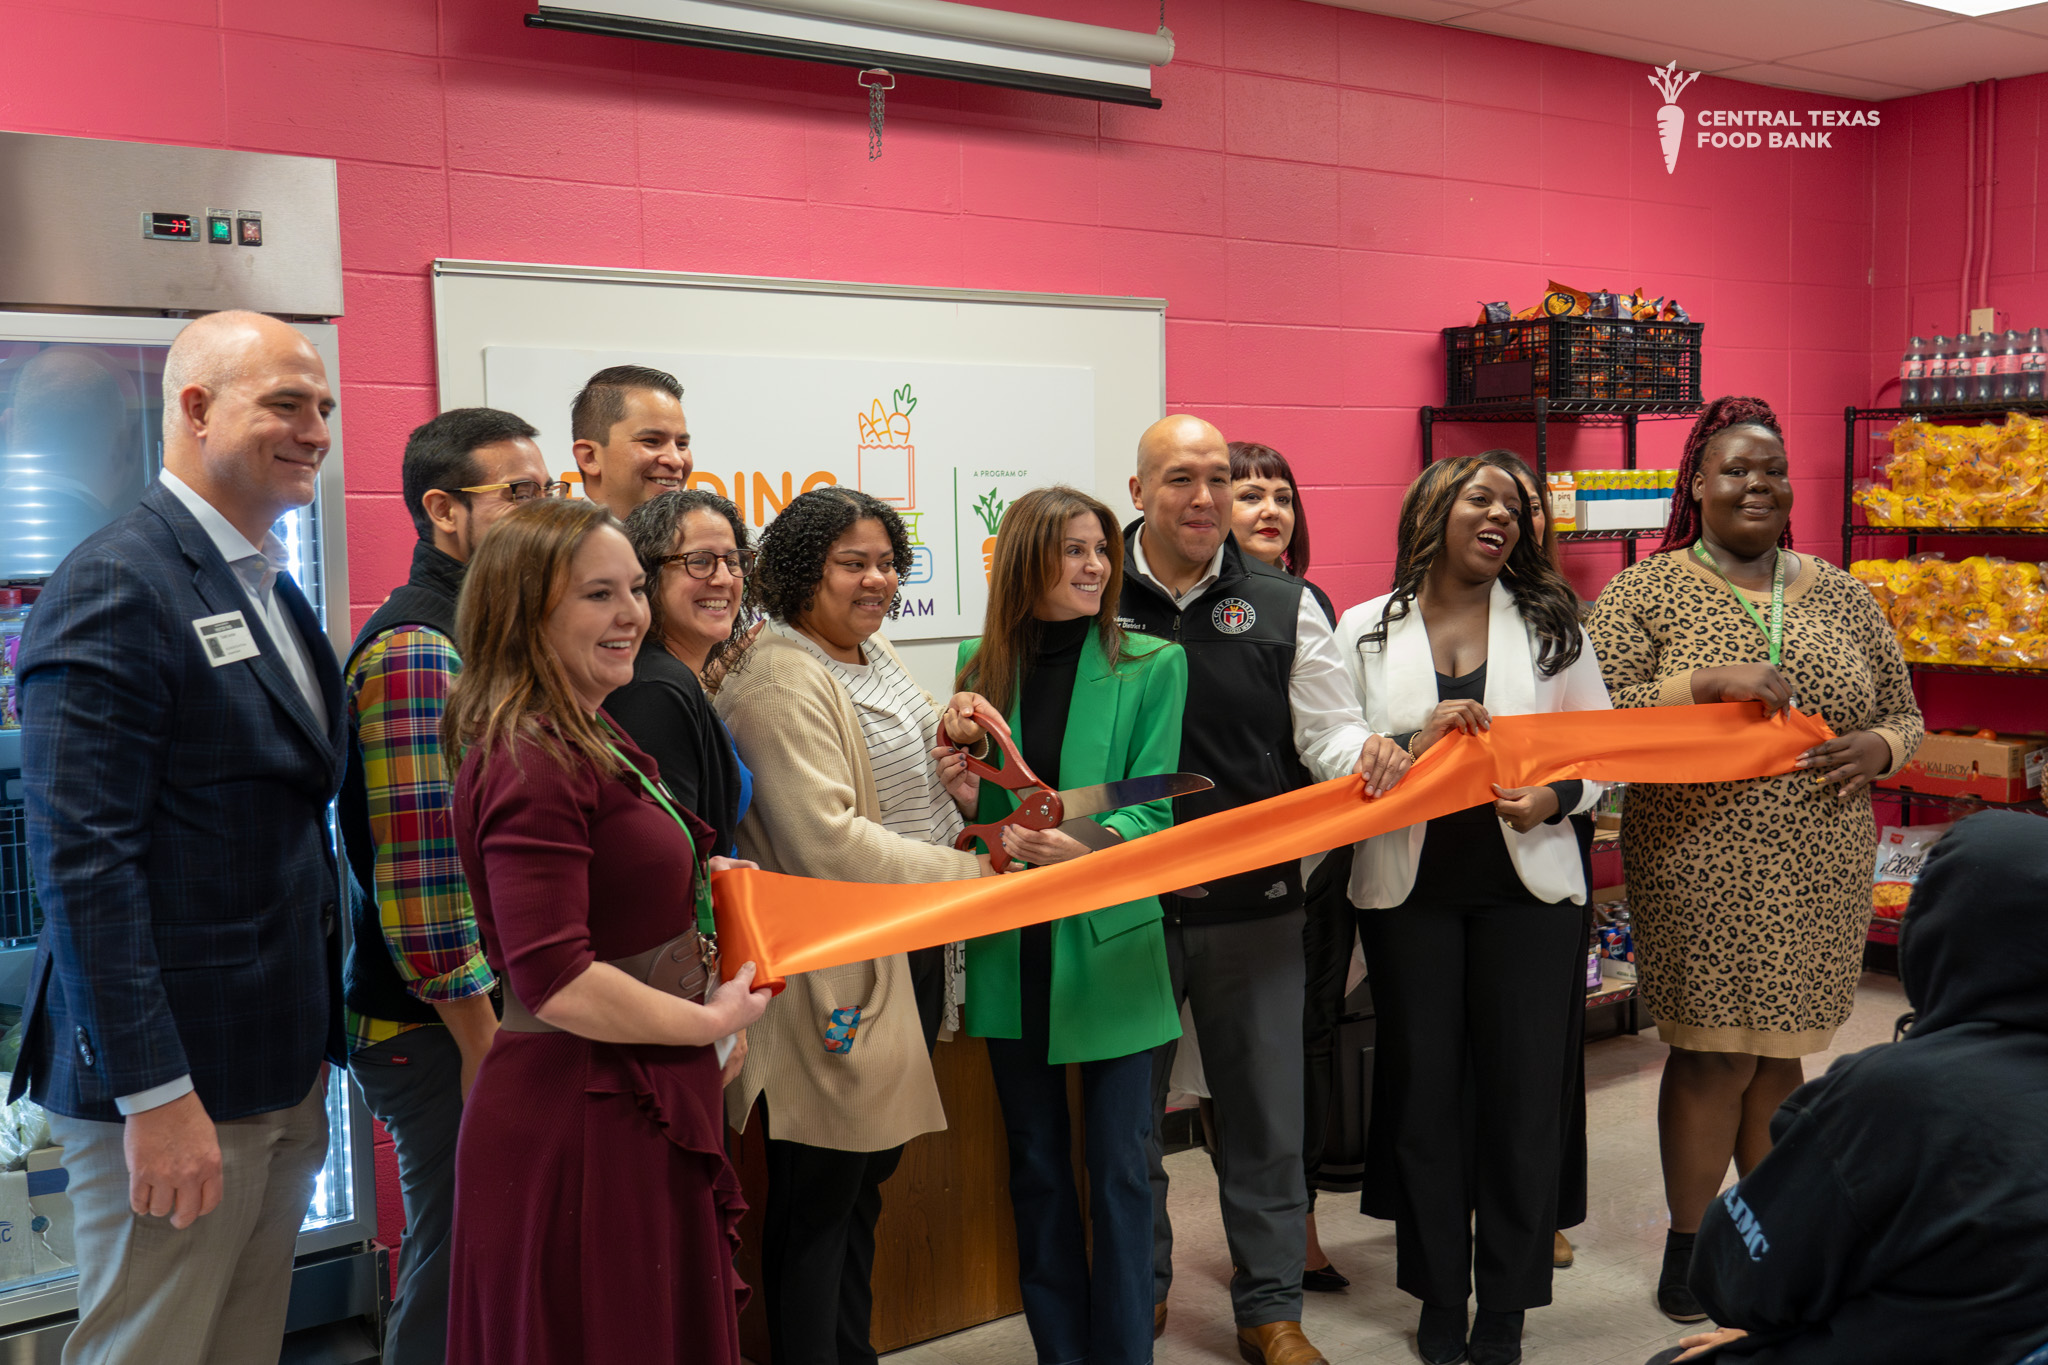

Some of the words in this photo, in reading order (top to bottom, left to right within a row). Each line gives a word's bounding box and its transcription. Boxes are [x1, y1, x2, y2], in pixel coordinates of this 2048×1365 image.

[171, 219, 187, 233] 37
[1773, 583, 1784, 602] TEXAS
[1772, 603, 1783, 623] FOOD
[1771, 624, 1782, 645] BANK
